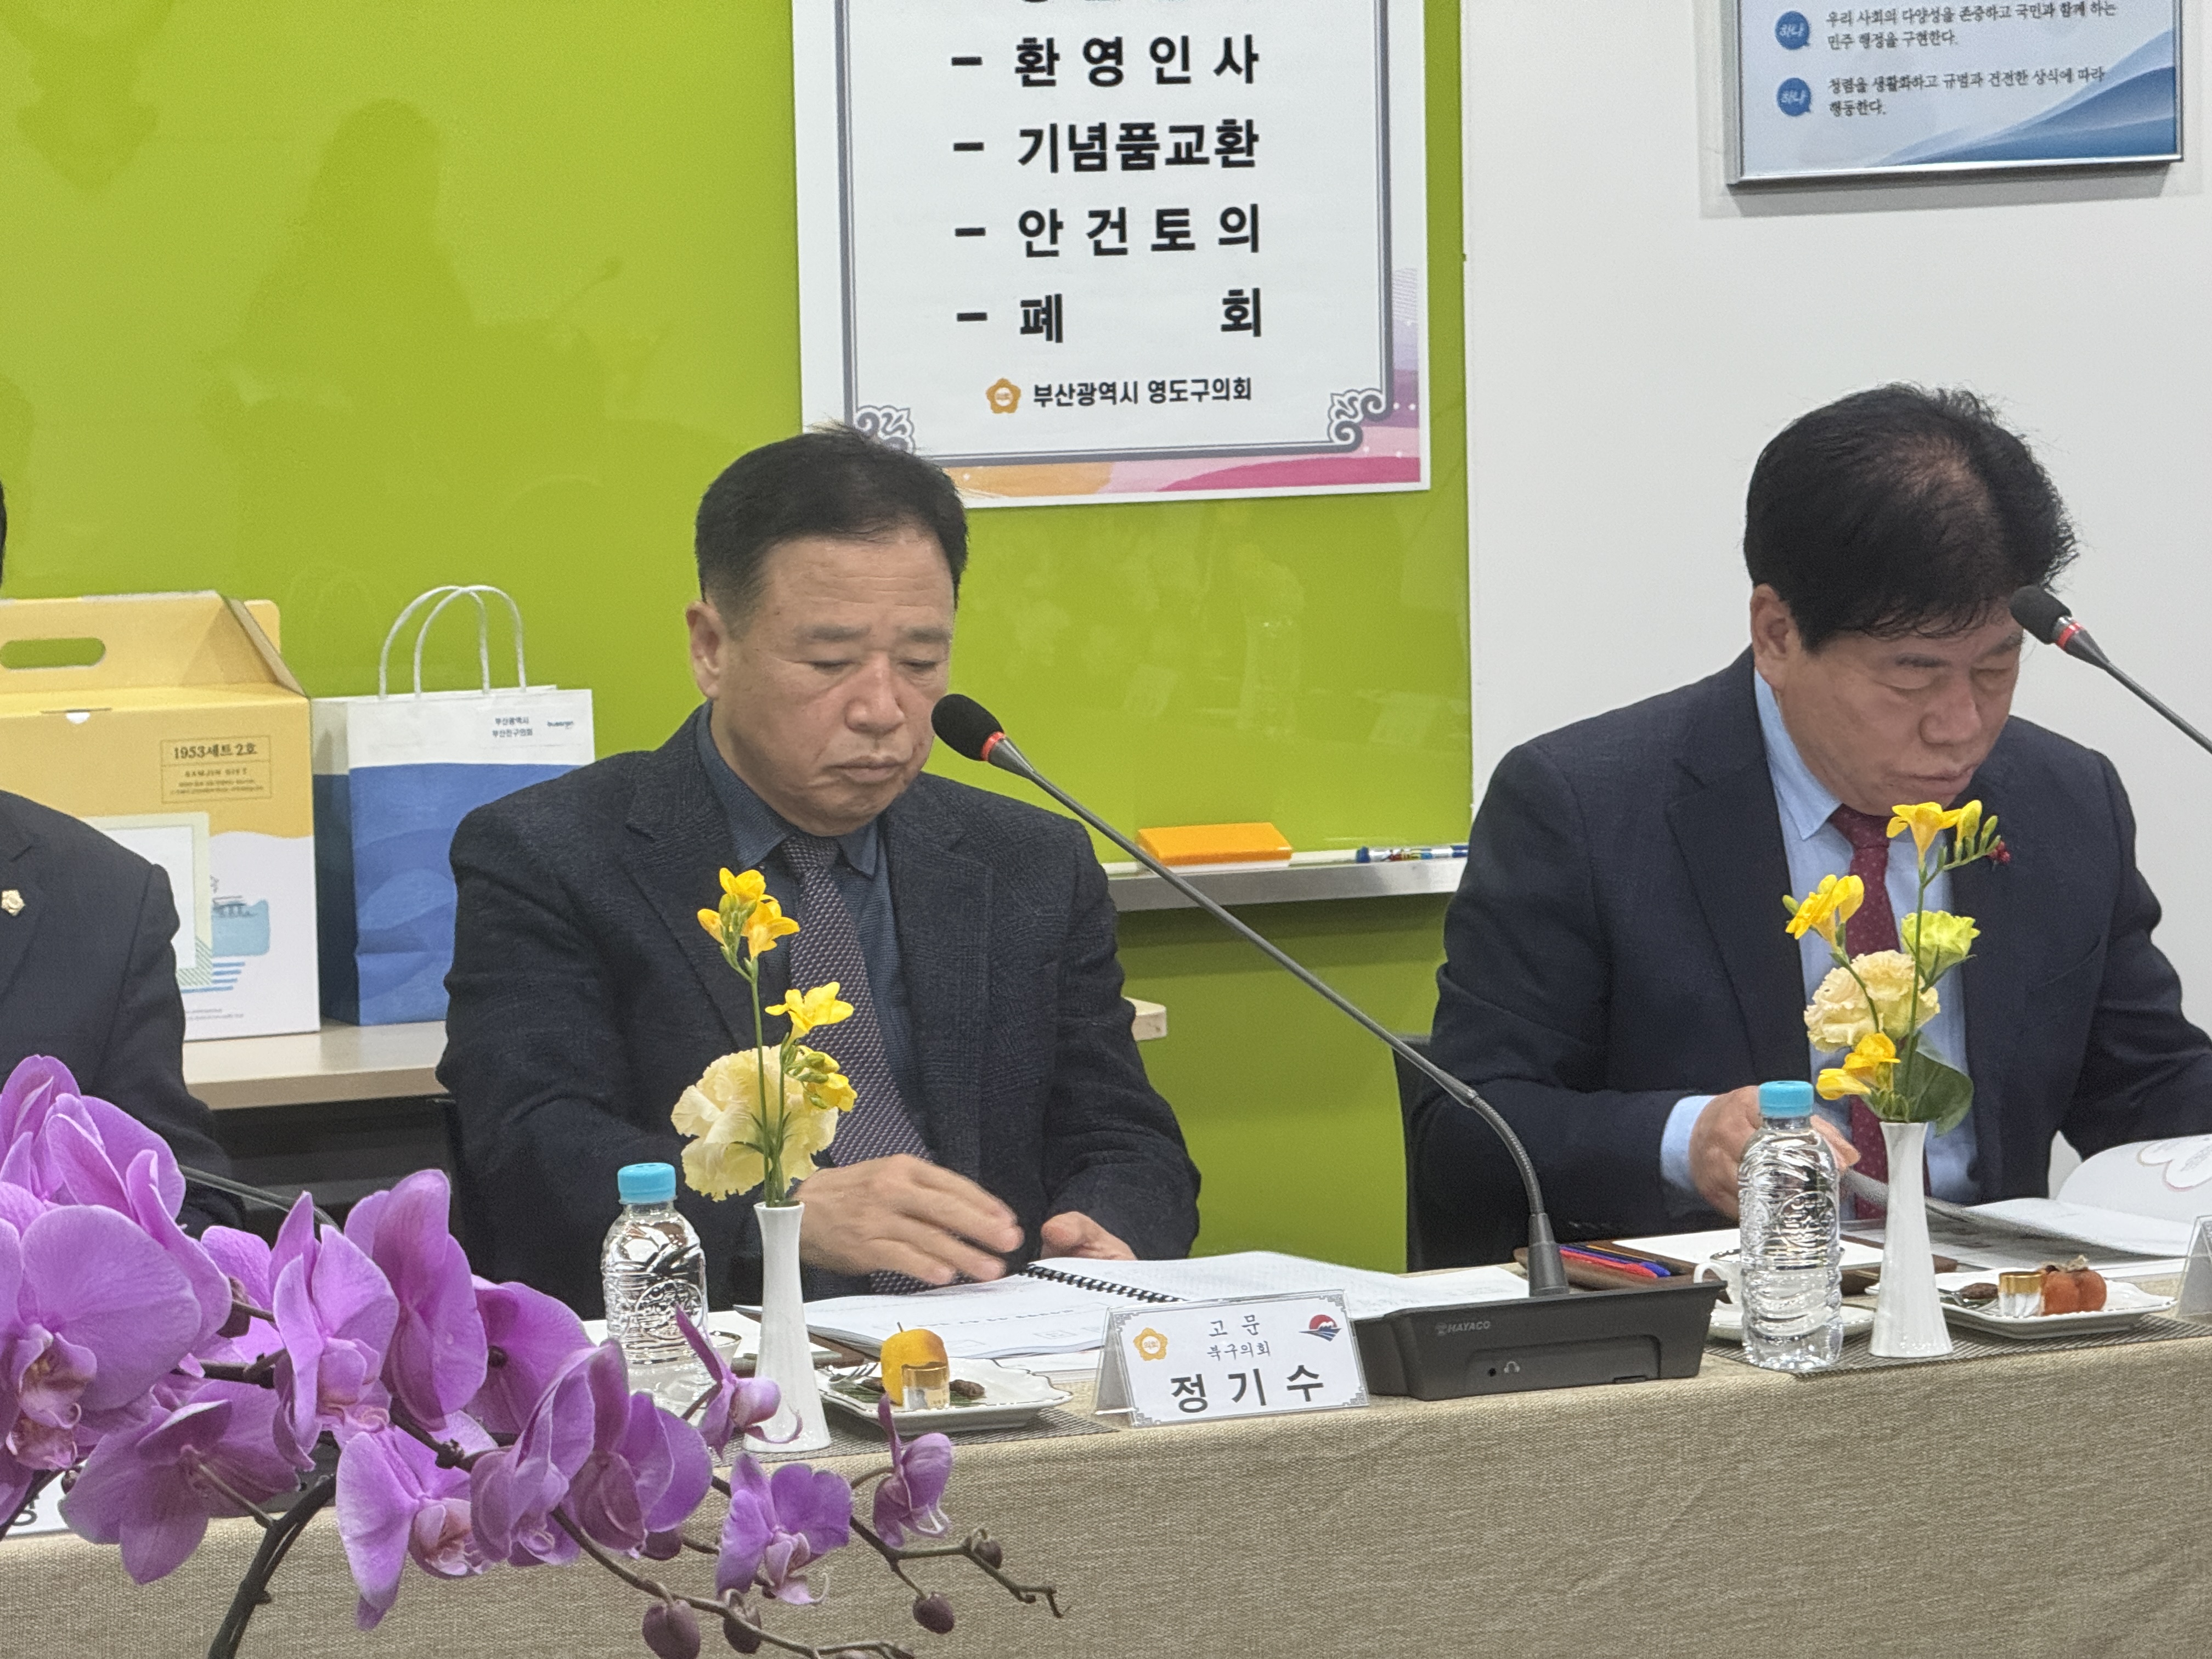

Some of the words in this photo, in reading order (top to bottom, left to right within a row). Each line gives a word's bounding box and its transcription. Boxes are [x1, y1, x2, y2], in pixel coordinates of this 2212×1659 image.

[1826, 10, 1853, 27] 우리
[1858, 8, 1897, 25] 사회의
[1902, 6, 1955, 24] 다양성을
[1959, 5, 2012, 22] 존중하고
[2015, 3, 2055, 20] 국민과
[2090, 0, 2117, 16] 하는
[1827, 33, 1854, 50] 민주
[1014, 33, 1260, 88] 환영인사
[1943, 72, 1983, 89] 규범과
[2032, 67, 2072, 86] 상식에
[2078, 66, 2105, 82] 따라
[1017, 119, 1259, 173] 기념품교환
[1018, 203, 1260, 258] 안건토의
[1034, 380, 1138, 408] 부산광역시
[1148, 376, 1251, 404] 영도구의회
[1447, 1321, 1491, 1333] HAYACO
[1207, 1340, 1271, 1361] 북구의회
